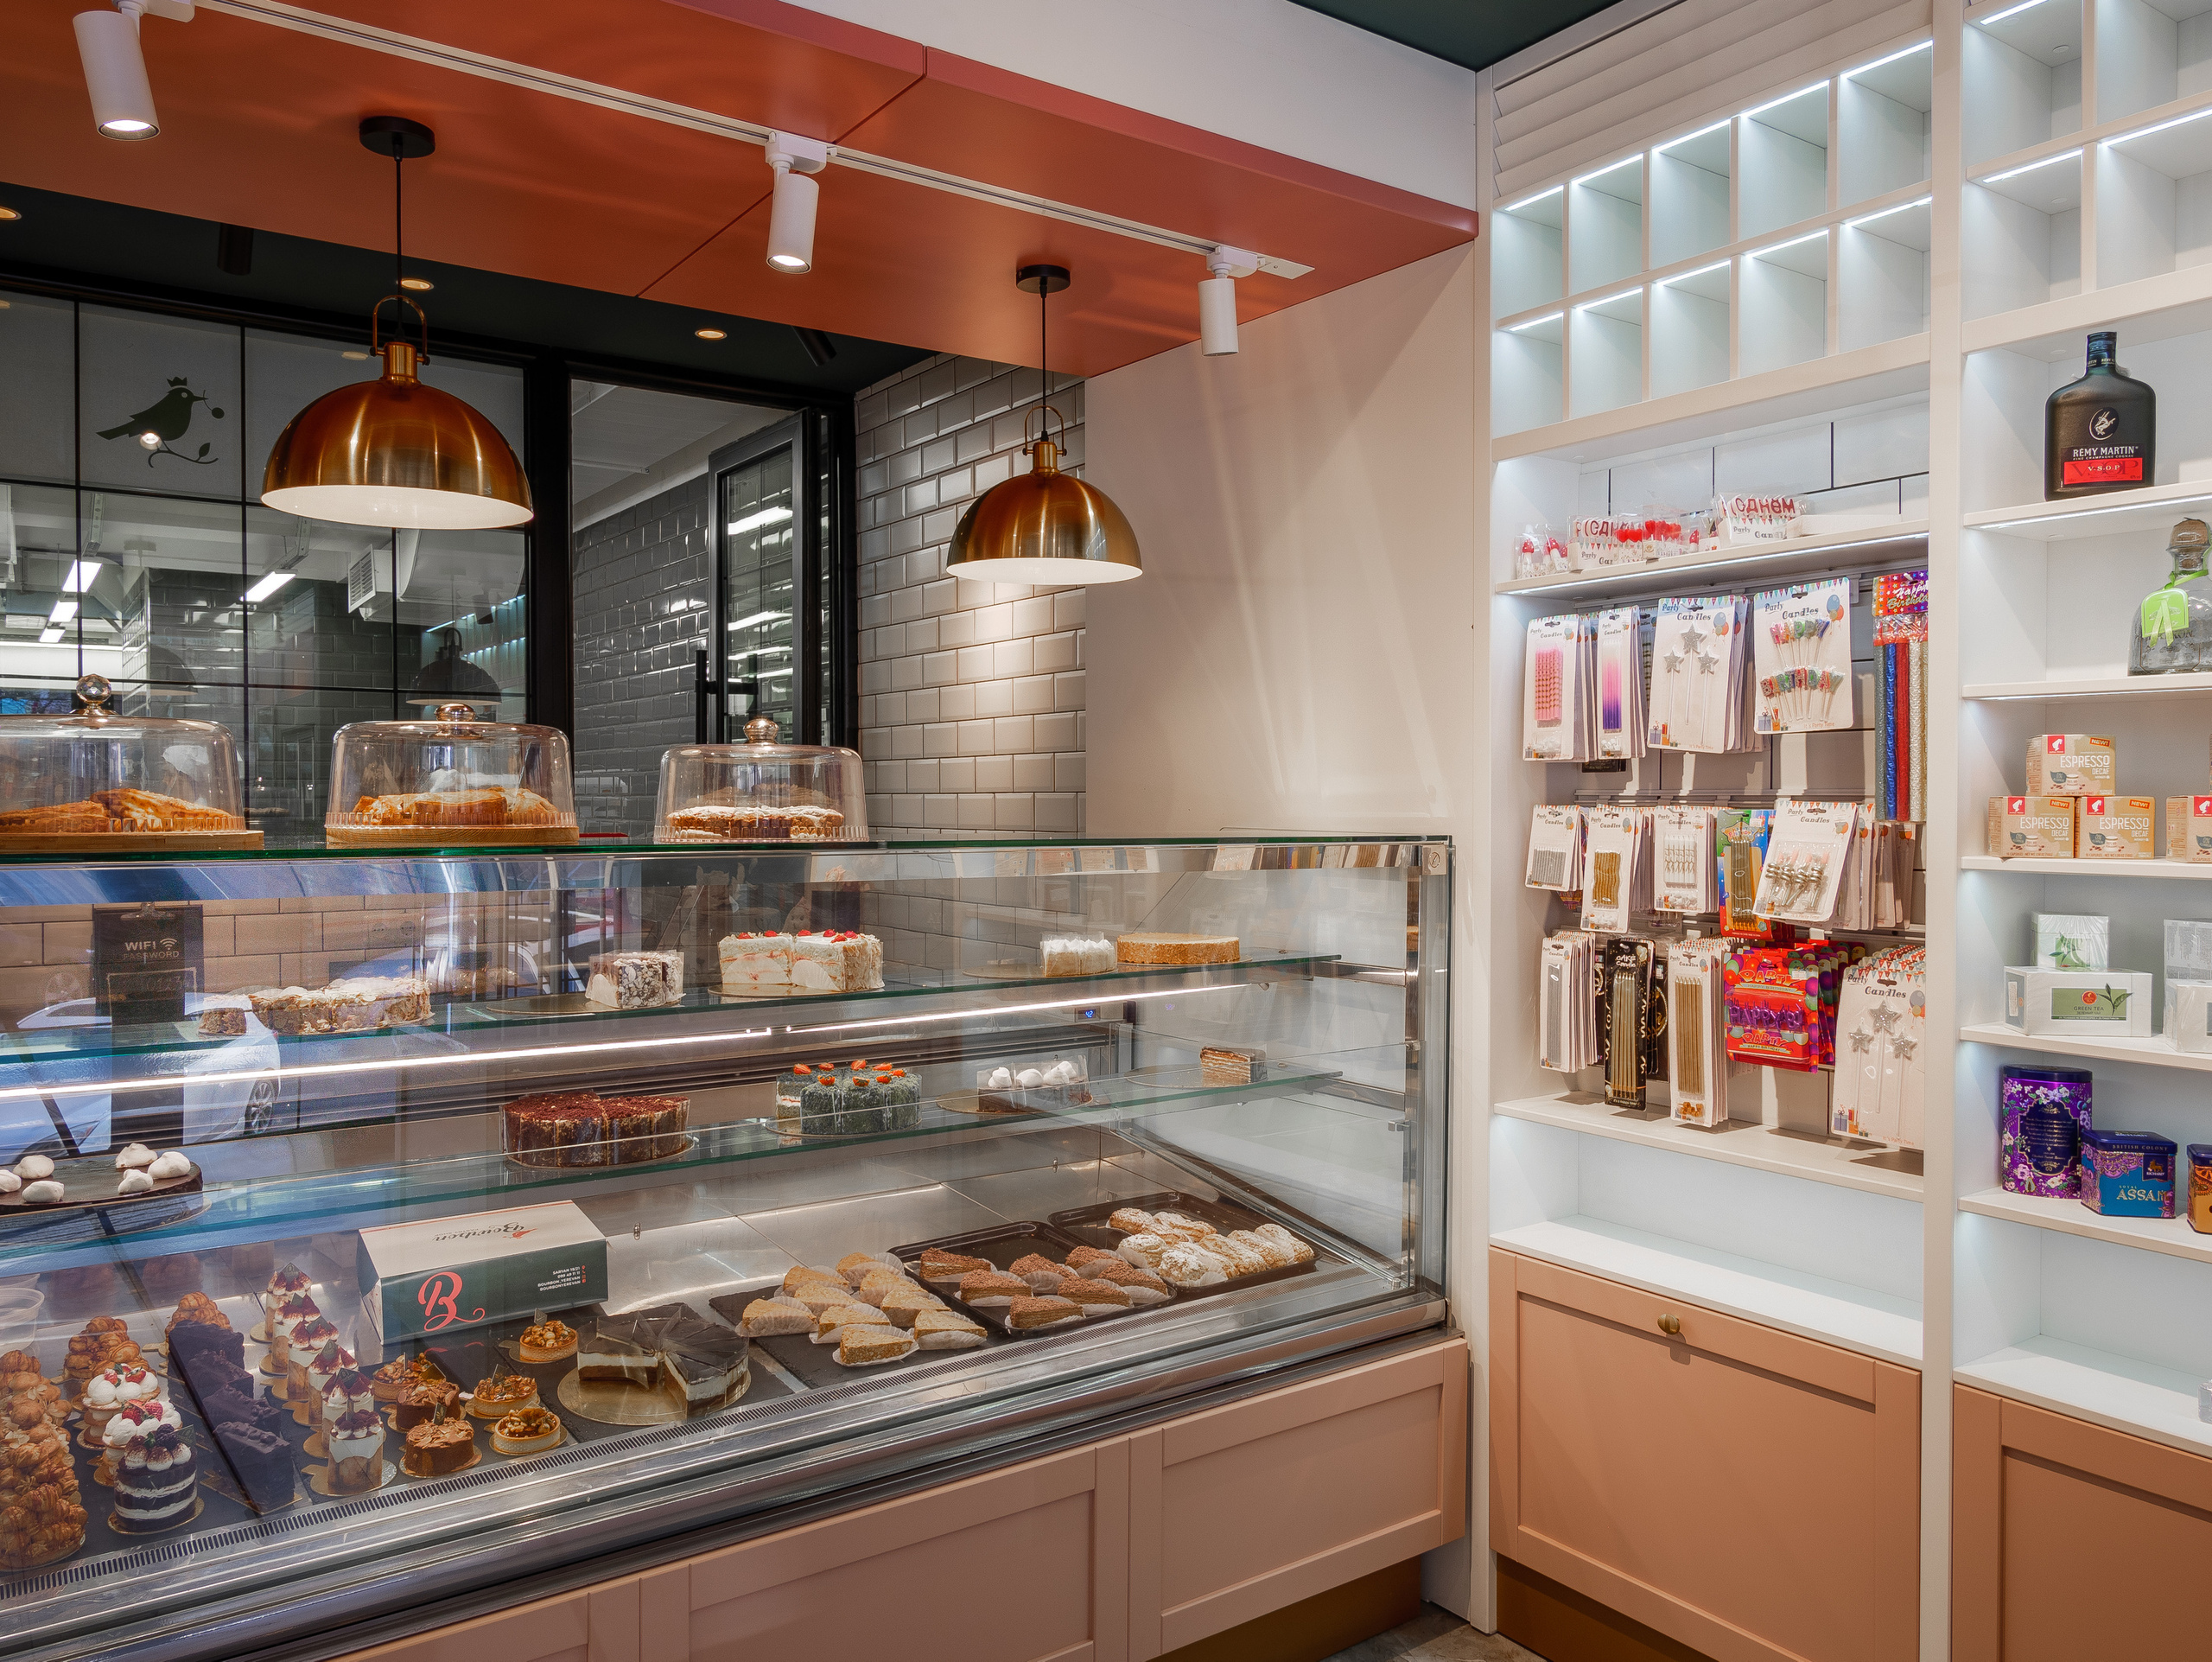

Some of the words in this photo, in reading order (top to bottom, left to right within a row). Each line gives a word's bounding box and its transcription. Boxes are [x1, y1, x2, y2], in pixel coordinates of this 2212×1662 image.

[2073, 448, 2098, 457] RÉMY
[2101, 446, 2134, 455] MARTIN
[1764, 602, 1783, 612] Party
[1887, 593, 1929, 609] Birthda
[1662, 603, 1680, 612] Party
[1782, 608, 1819, 620] Candles
[2060, 755, 2110, 768] ESPRESSO
[2019, 817, 2069, 830] ESPRESSO
[2099, 817, 2149, 830] ESPRESSO
[124, 940, 156, 951] WIFI
[123, 950, 180, 961] PASSWORD
[1738, 969, 1802, 987] PARTY
[1847, 974, 1868, 984] Party
[1865, 986, 1906, 998] Candles
[1742, 1033, 1789, 1047] PARTY
[432, 1222, 524, 1241] Bourbon
[417, 1271, 486, 1332] B
